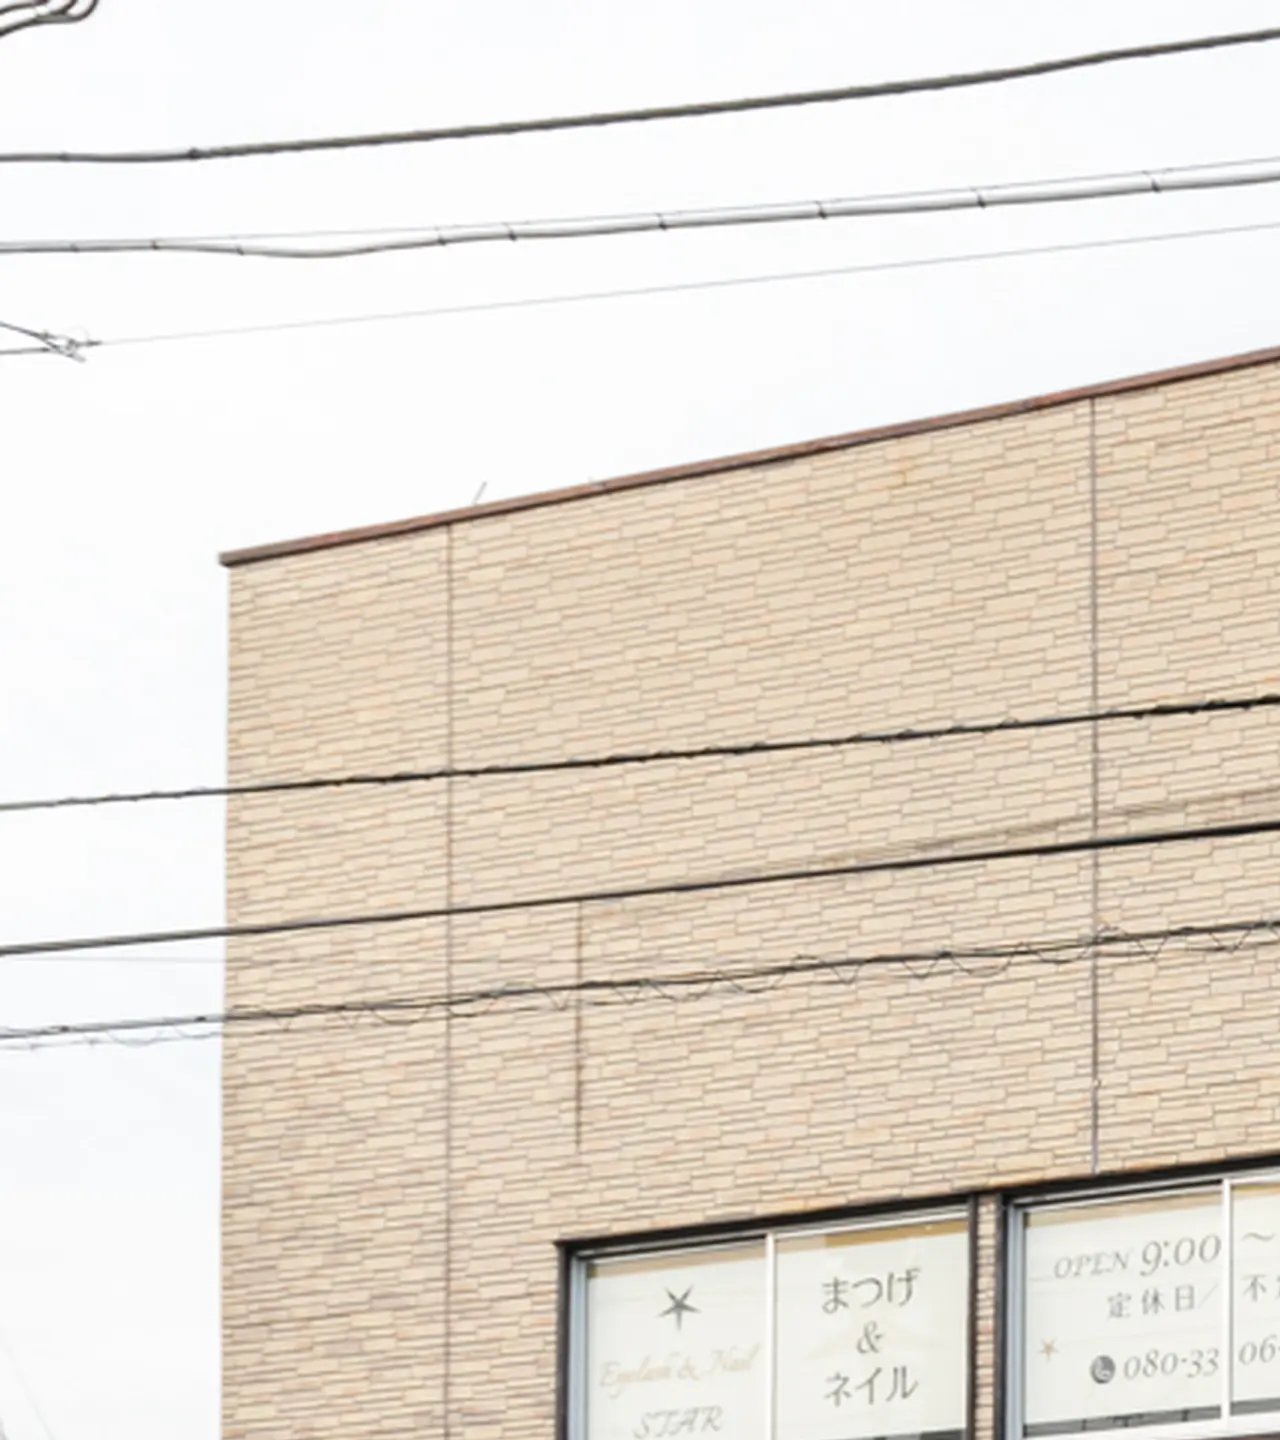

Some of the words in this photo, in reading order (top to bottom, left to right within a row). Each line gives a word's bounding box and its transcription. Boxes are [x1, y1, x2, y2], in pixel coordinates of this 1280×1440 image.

[1054, 1250, 1131, 1279] OPEN
[1139, 1233, 1221, 1277] 9:00
[821, 1268, 920, 1314] まつげ
[856, 1321, 884, 1353] &
[824, 1366, 918, 1407] ネイル
